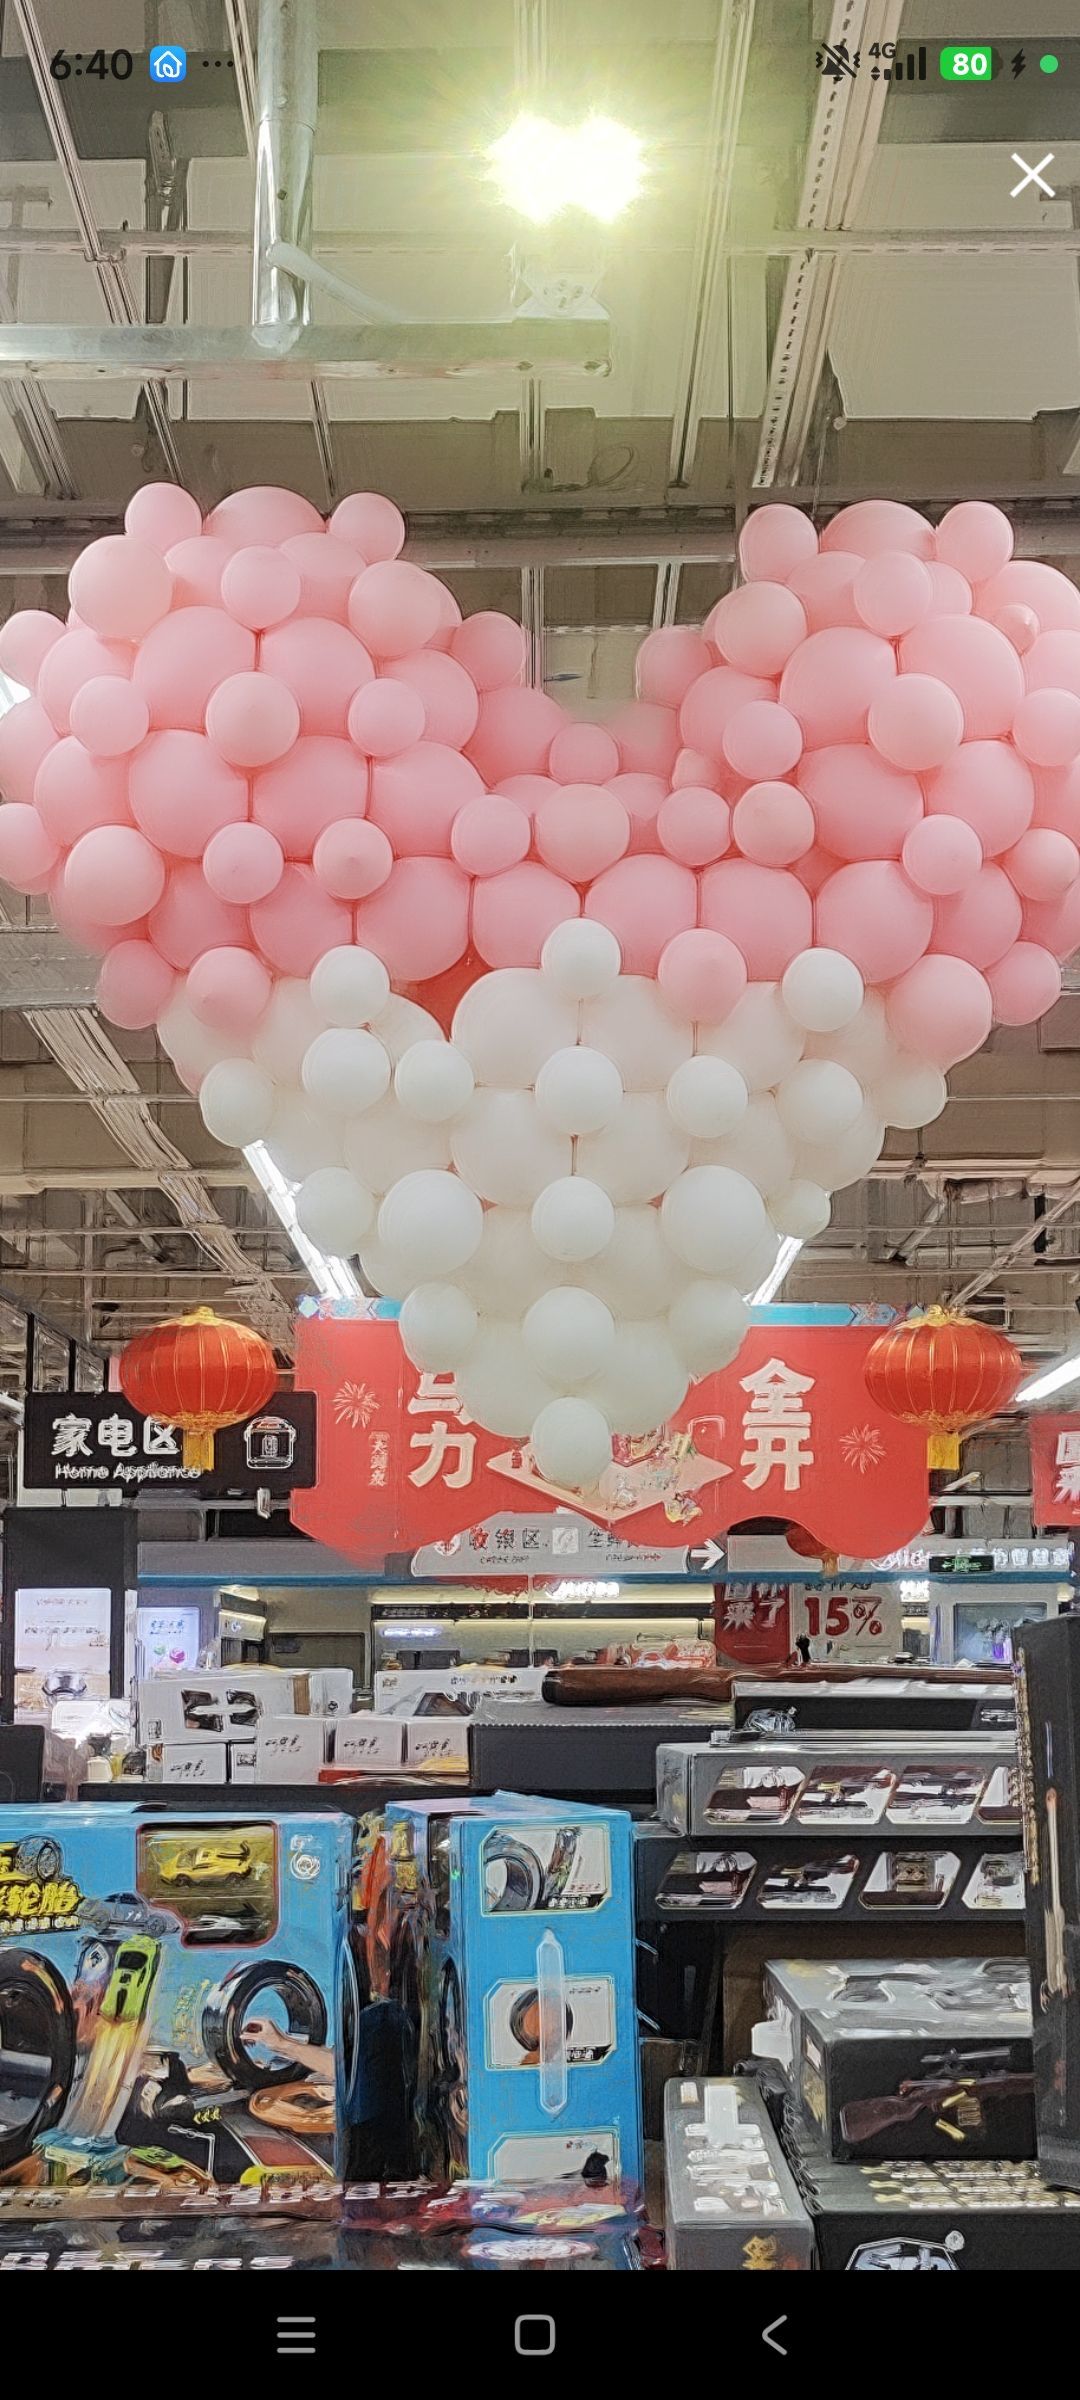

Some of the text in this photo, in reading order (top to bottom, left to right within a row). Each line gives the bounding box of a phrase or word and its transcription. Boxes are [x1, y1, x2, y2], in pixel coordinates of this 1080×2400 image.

[51, 1412, 181, 1457] 家电区
[739, 1357, 816, 1491] 全开
[55, 1462, 110, 1480] Home
[804, 1596, 883, 1637] 15%
